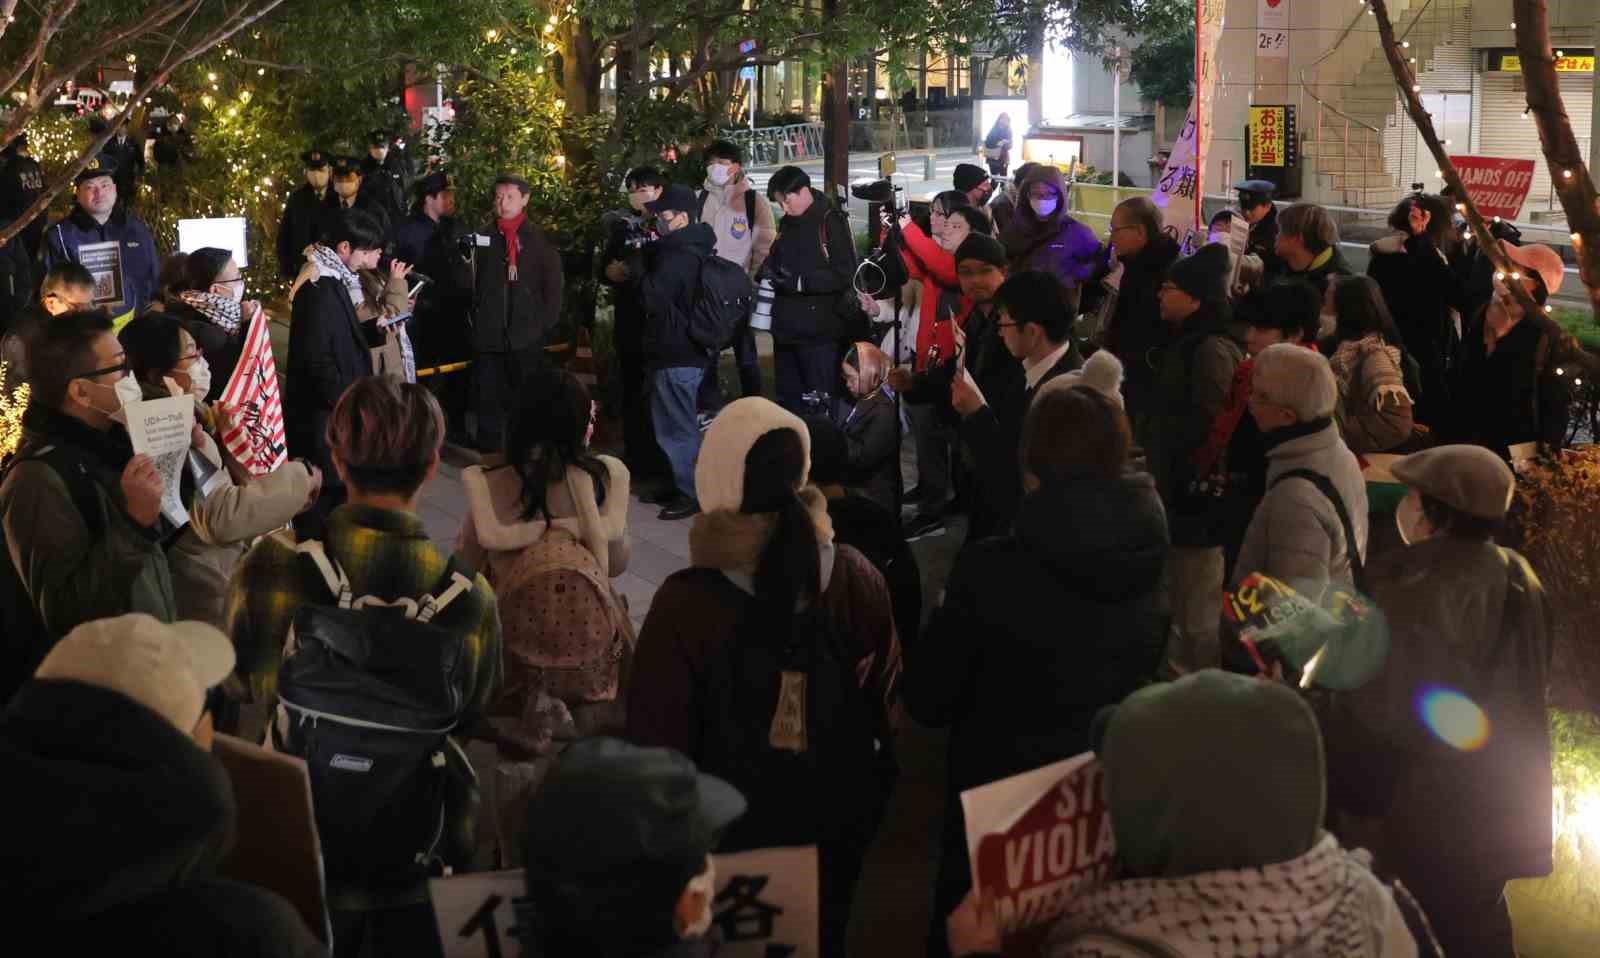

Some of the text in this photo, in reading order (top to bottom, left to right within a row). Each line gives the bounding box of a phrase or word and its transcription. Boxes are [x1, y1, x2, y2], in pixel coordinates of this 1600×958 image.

[1261, 109, 1276, 164] お弁当
[1504, 171, 1533, 188] OFF
[1056, 765, 1098, 820] ST
[1004, 812, 1116, 889] VIOLA
